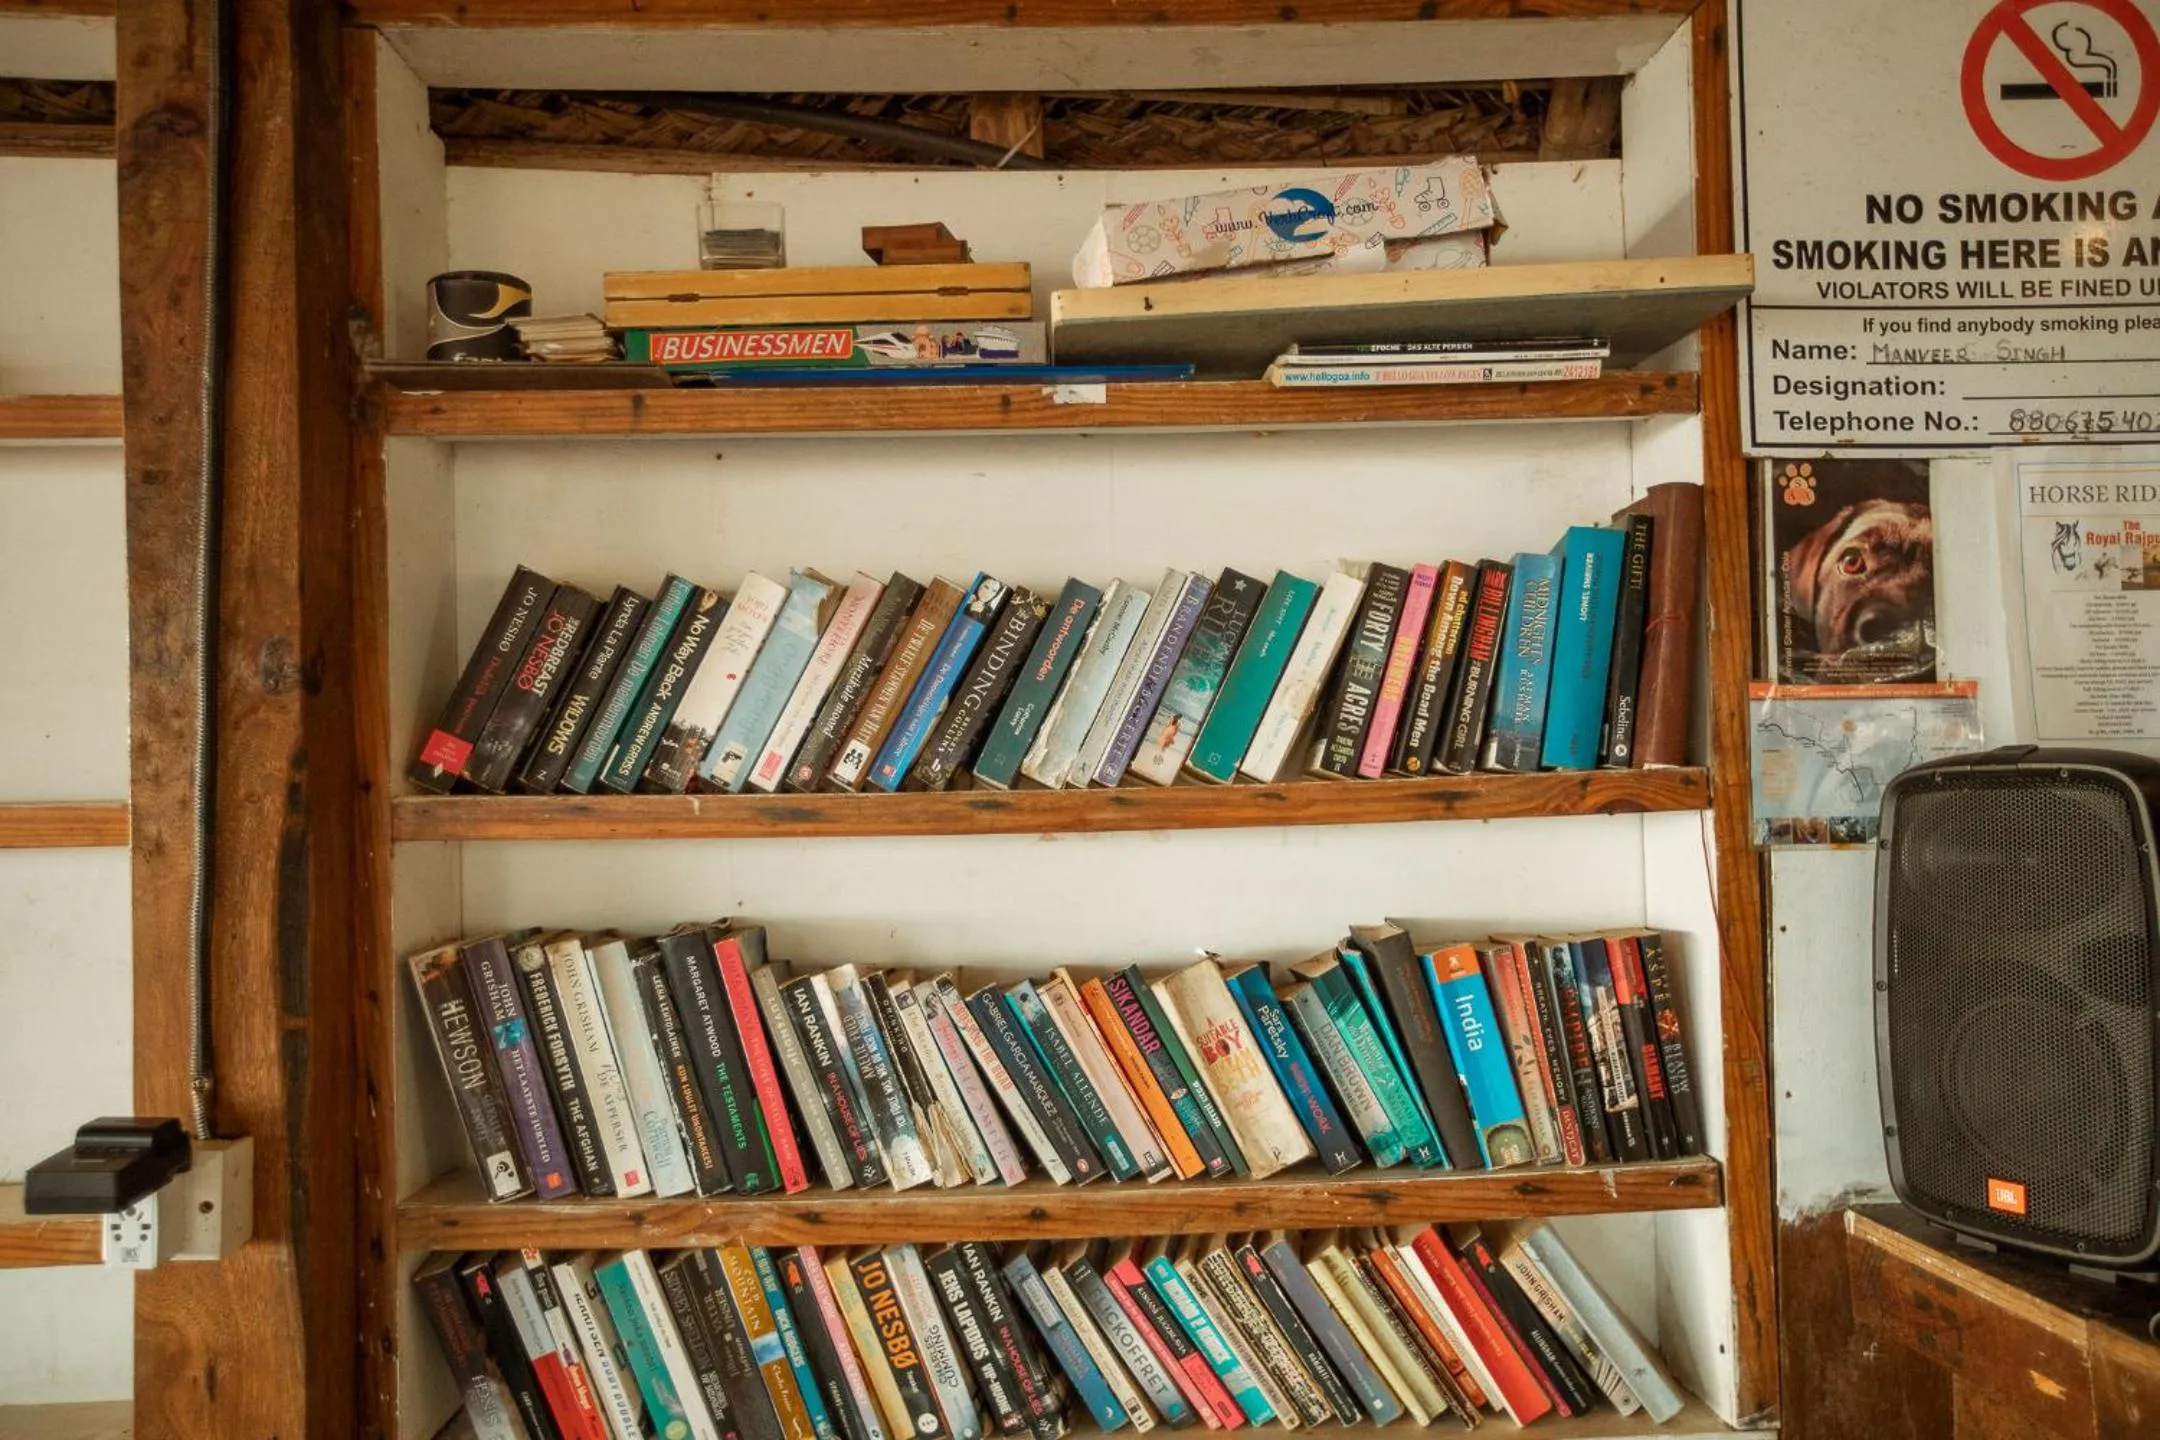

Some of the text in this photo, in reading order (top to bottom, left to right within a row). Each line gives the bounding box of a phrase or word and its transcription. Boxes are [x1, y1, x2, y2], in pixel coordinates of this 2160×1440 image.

[1865, 194, 1923, 224] NO
[1938, 190, 2137, 224] SMOKING
[1773, 238, 2110, 270] SMOKING HERE IS
[1817, 279, 2131, 299] VIOLATORS WILL BE FINED
[663, 333, 846, 360] BUSINESSMEN
[1772, 339, 1857, 360] Name:
[1863, 318, 1874, 333] If
[1879, 320, 1912, 338] you
[1918, 317, 1951, 333] find
[1957, 316, 2034, 338] anybody
[2040, 315, 2119, 336] smoking
[1996, 339, 2066, 362] SINGH
[1773, 375, 1946, 400] Designation:
[1774, 410, 1979, 435] Telephone No.:
[2029, 485, 2109, 503] HORSE
[1632, 523, 1646, 550] THE
[2086, 531, 2120, 547] Royal
[2123, 520, 2140, 531] The
[1582, 551, 1594, 588] SHRIVER
[521, 585, 539, 607] JO
[545, 608, 567, 634] JO
[1515, 579, 1538, 658] CHILDREN
[1578, 589, 1591, 621] LIONEL
[1034, 596, 1085, 683] De antwoorden
[1358, 600, 1394, 652] FORTY
[1468, 586, 1503, 662] BILLINGHAM
[529, 621, 576, 699] REDBREAST
[546, 595, 639, 756] Lynda La Plante WIDOWS
[962, 613, 1026, 714] BINDING
[1408, 574, 1464, 748] Down Among the Dead Men
[617, 612, 709, 776] No Way Back ANDREW GROSS
[821, 652, 873, 738] Muzikale moord
[1335, 680, 1372, 735] ACRES
[1459, 666, 1480, 723] BURNING
[937, 707, 967, 754] COLLINS
[1453, 723, 1468, 750] GIRL
[478, 959, 507, 1021] GRISHAM
[1645, 945, 1665, 1002] ASPE
[497, 982, 517, 1018] JOHN
[560, 951, 599, 1054] JOHN GRISHAM
[792, 986, 812, 1013] IAN
[979, 990, 1010, 1033] GABRIEL
[1107, 976, 1163, 1056] SIKANDAR
[1268, 1007, 1288, 1033] Sara
[1454, 992, 1488, 1052] India
[437, 997, 488, 1090] HEWSON
[650, 973, 668, 1001] LEENA
[675, 1063, 688, 1083] KUN
[683, 954, 749, 1150] MARGARET ATWOOD THE TESTAMENTS
[800, 1012, 834, 1067] RANKIN
[1253, 1004, 1292, 1061] Paretsky
[509, 1047, 525, 1073] HET
[527, 971, 600, 1171] FREDERICK FORSYTH THE AFGHAN
[1043, 1025, 1075, 1070] ISABEL
[1069, 1069, 1109, 1127] ALLENDE
[1318, 1021, 1344, 1055] DAN
[1336, 1053, 1376, 1112] BROWN
[1549, 1058, 1567, 1101] MEMORY
[1671, 1042, 1689, 1092] BLAUW
[515, 1072, 538, 1119] LAATSTE
[831, 1090, 854, 1126] HOUSE
[1304, 1094, 1333, 1135] WORK
[640, 1109, 673, 1169] Cornwell
[852, 1139, 868, 1162] LIES
[726, 1254, 762, 1331] MOUNTAIN
[741, 1266, 761, 1302] COLD
[1514, 1260, 1566, 1322] JOHN GRISHAM
[856, 1258, 920, 1372] JO NESBØ
[937, 1267, 965, 1303] JENS
[951, 1300, 990, 1361] LAPIDUS
[961, 1242, 981, 1269] IAN
[972, 1268, 1004, 1323] RANKIN
[1007, 1346, 1028, 1379] HOUSE
[1020, 1377, 1034, 1395] OF
[1027, 1392, 1044, 1417] LIES
[920, 1334, 950, 1385] CHARLES
[925, 1323, 963, 1389] CUMMING
